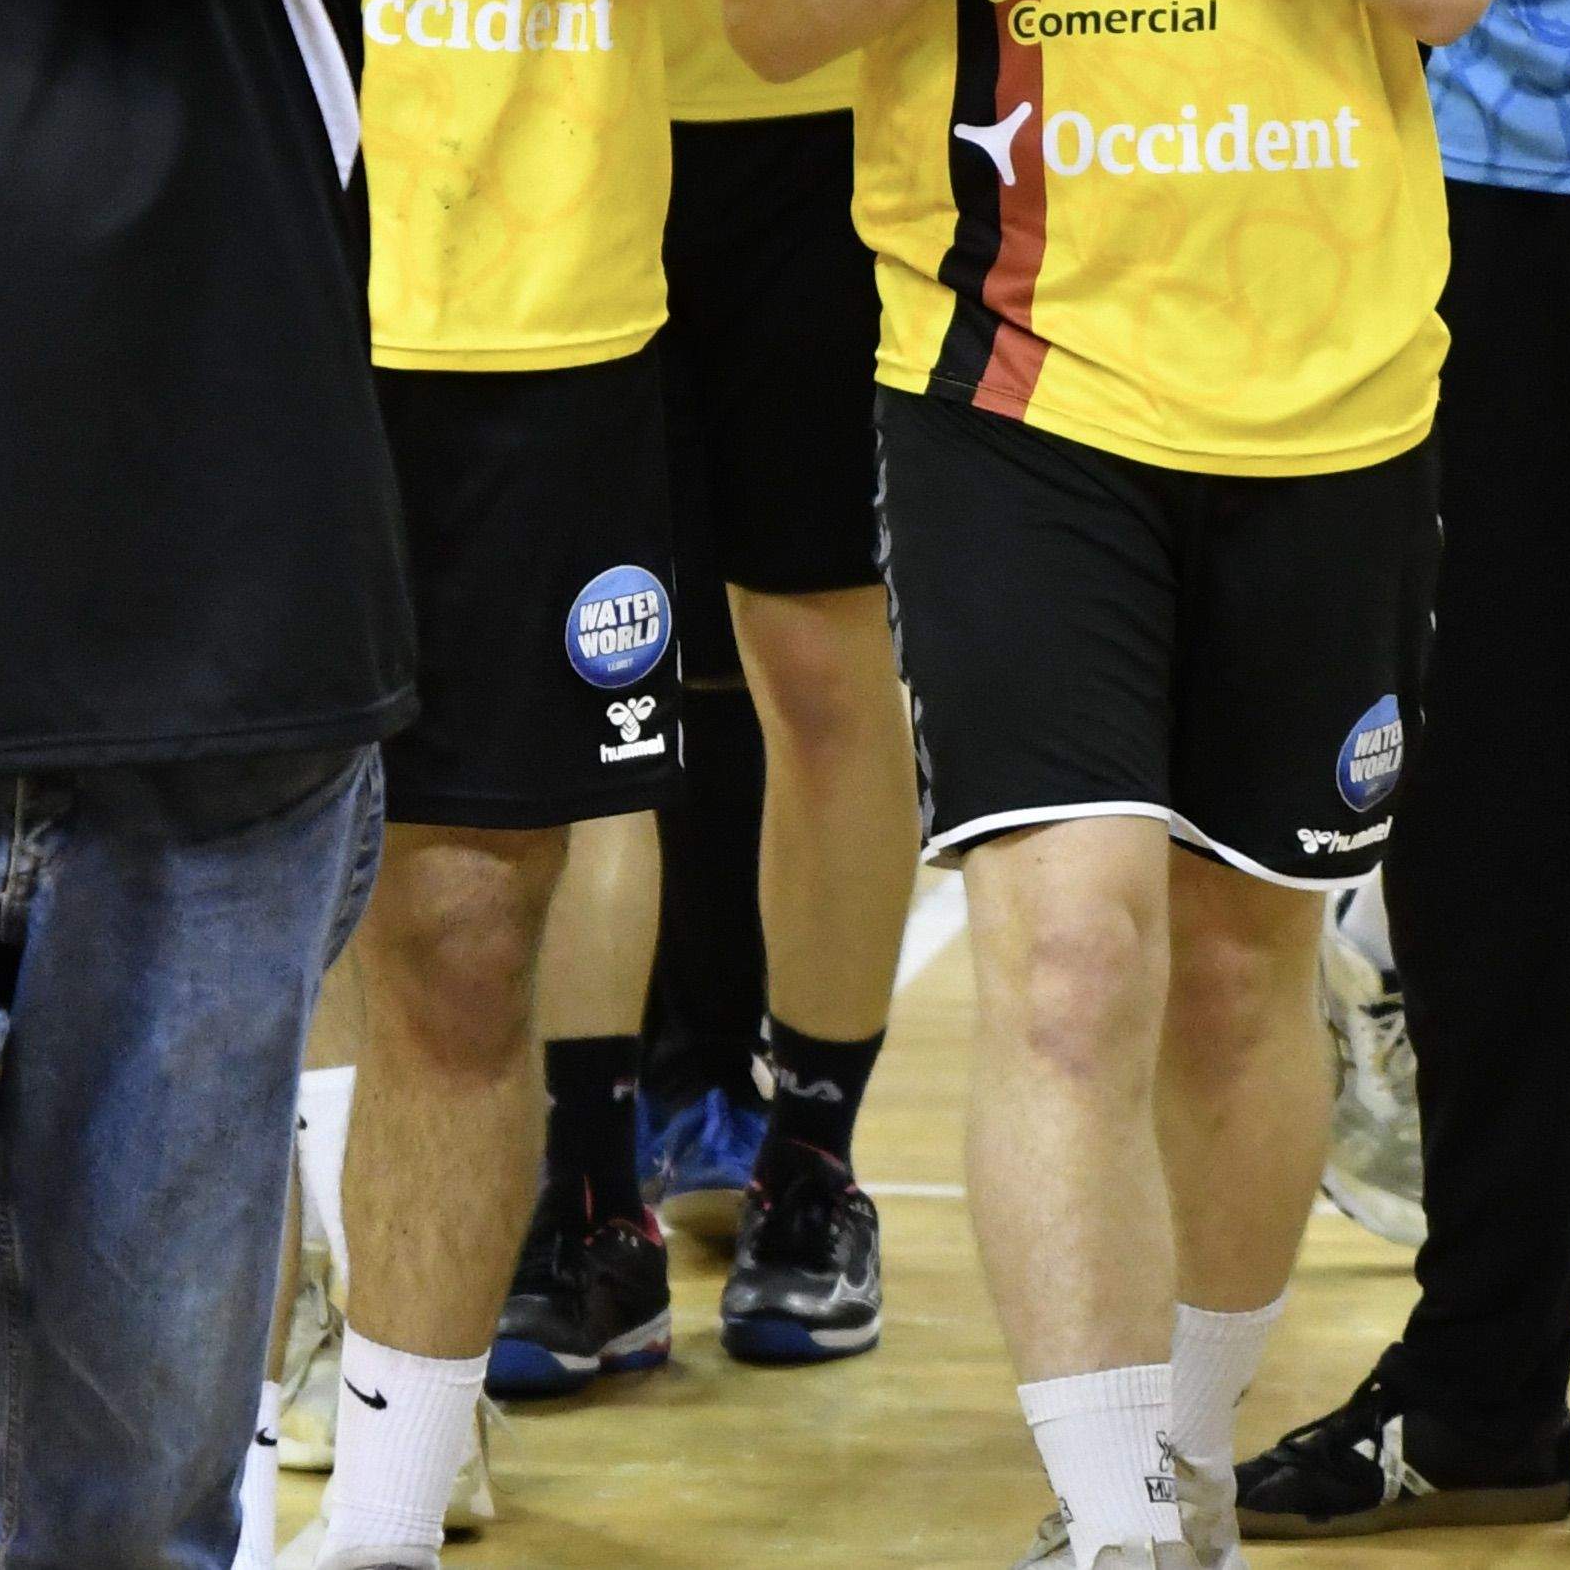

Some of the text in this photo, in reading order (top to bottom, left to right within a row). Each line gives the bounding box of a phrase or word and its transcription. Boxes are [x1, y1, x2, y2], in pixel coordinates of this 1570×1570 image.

[1042, 103, 1361, 177] Occident
[580, 589, 660, 632] WATER
[577, 616, 660, 660] WORLD
